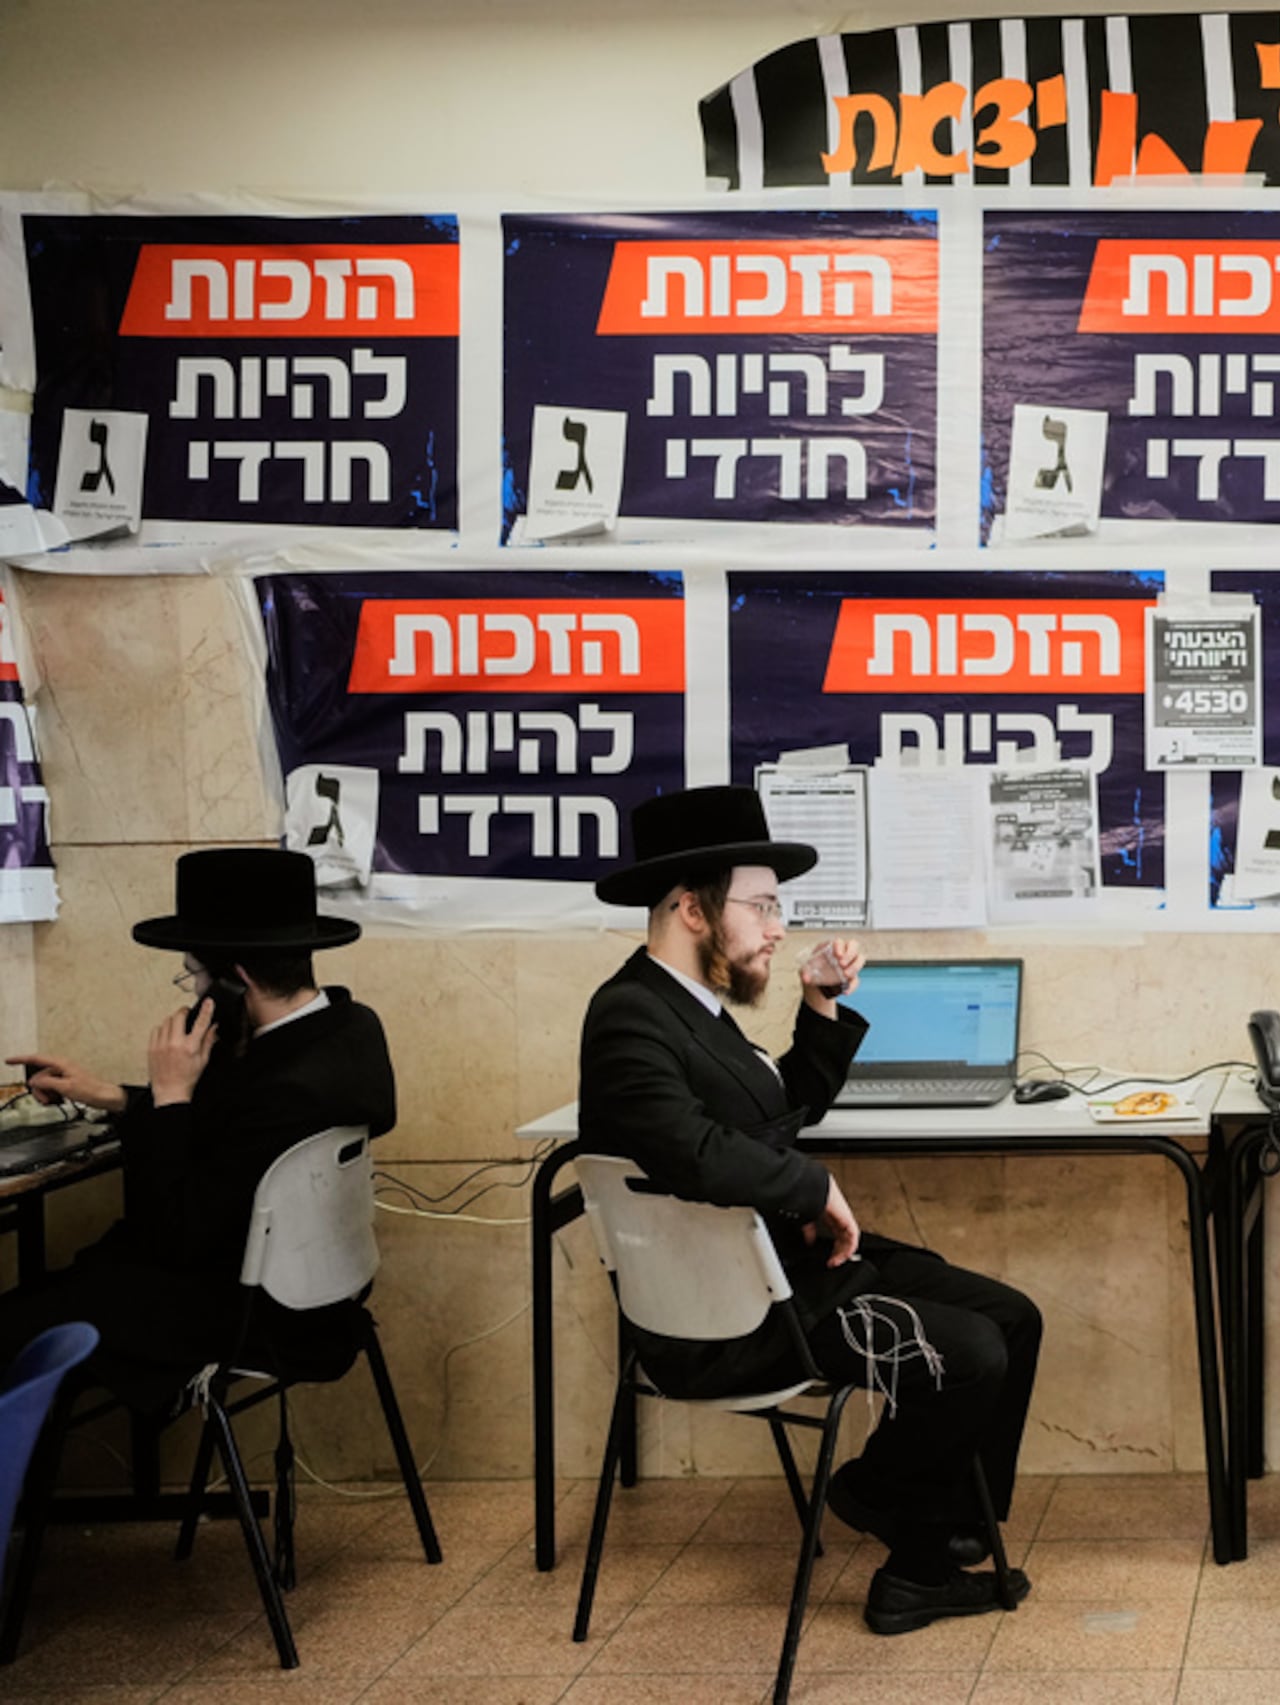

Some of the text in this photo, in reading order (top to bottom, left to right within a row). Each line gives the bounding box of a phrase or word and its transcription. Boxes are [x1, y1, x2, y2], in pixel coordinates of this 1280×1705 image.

[167, 260, 413, 318] הזכות
[641, 254, 892, 317] הזכות
[171, 350, 405, 417] להיות
[648, 345, 884, 416] להיות
[80, 418, 115, 495] ג
[190, 442, 388, 501] חרדי
[555, 417, 592, 493] ג
[666, 438, 867, 499] חרדי
[1037, 416, 1071, 491] ג
[390, 615, 639, 674] הזכות
[868, 615, 1120, 675] הזכות
[1164, 631, 1246, 649] הצבעתי
[399, 705, 632, 772] להיות
[420, 797, 617, 856] חרדי
